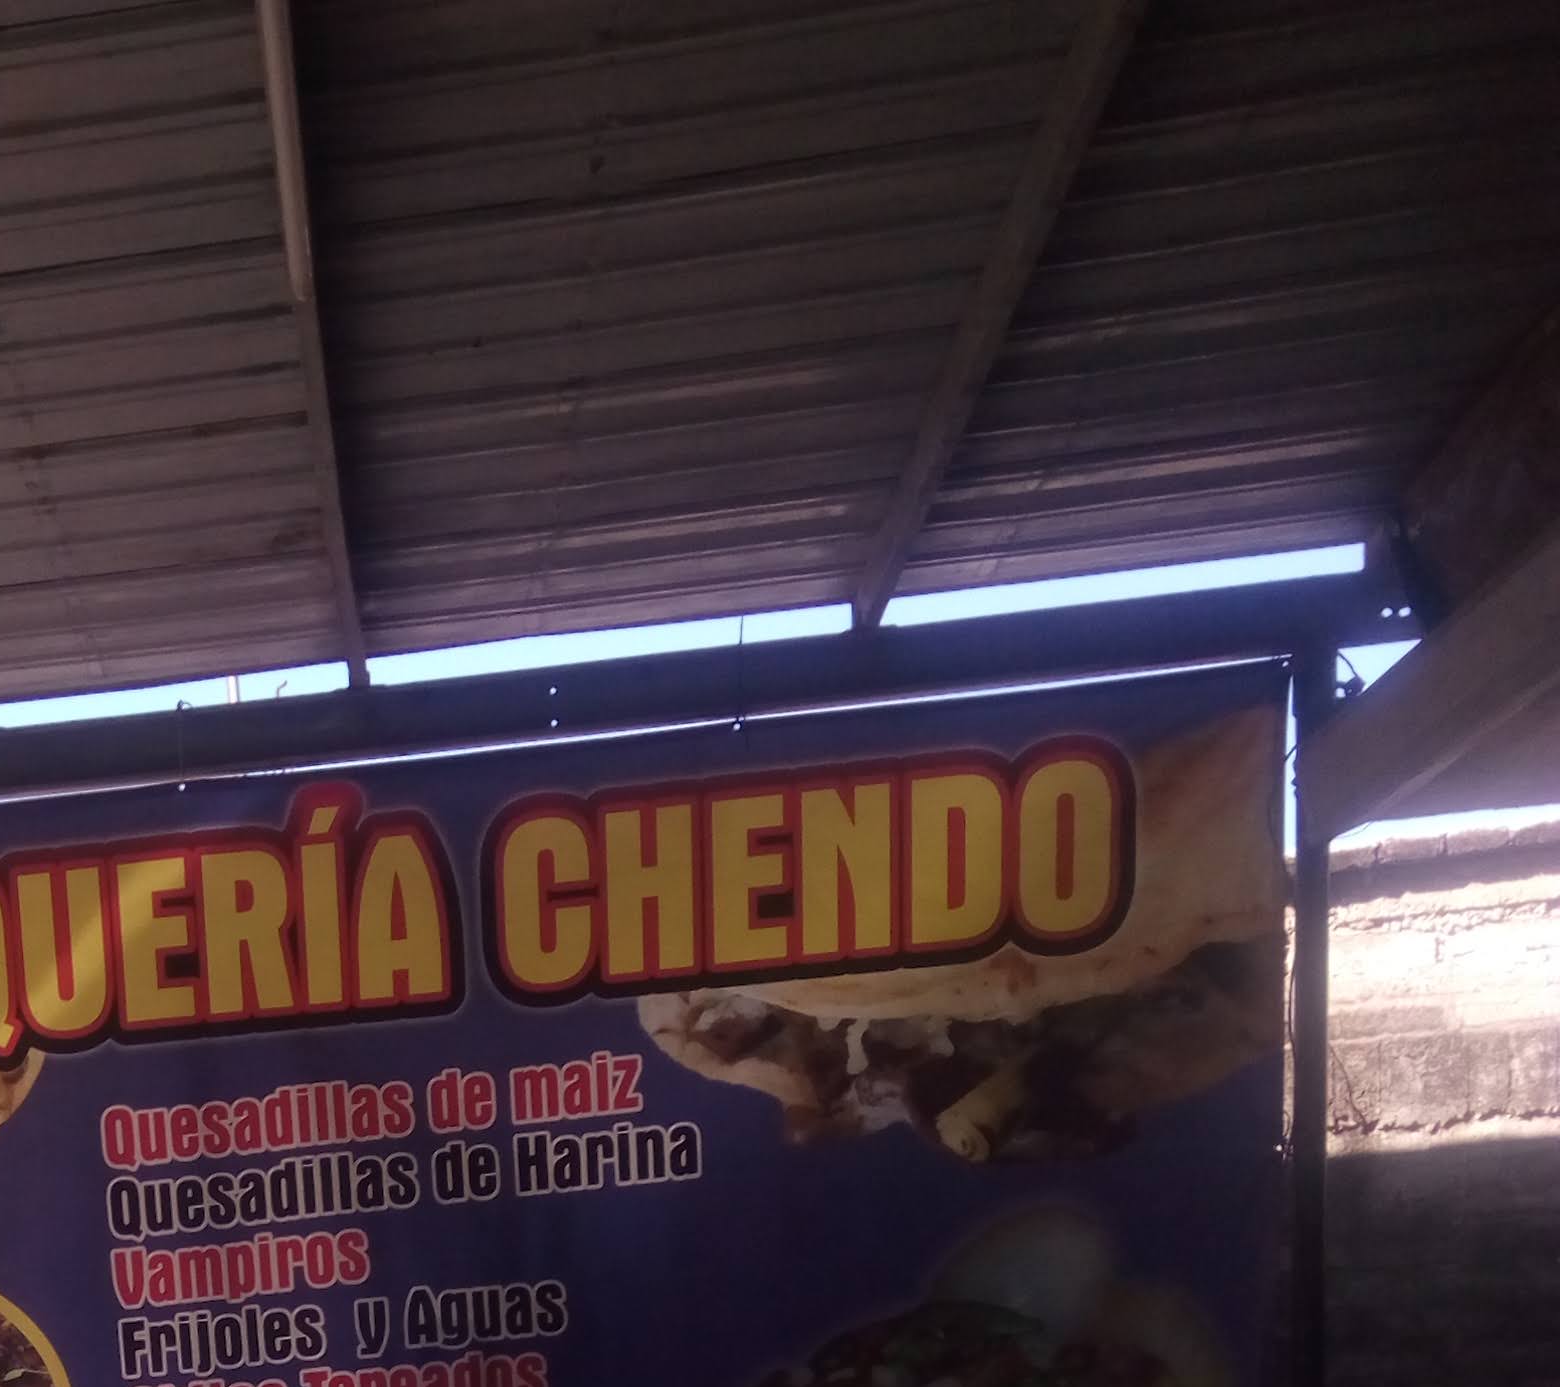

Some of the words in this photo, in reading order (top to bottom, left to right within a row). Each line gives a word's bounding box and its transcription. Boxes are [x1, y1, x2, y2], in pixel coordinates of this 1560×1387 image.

[496, 750, 1122, 994] CHENDO
[101, 1080, 415, 1169] Quesadillas
[427, 1069, 496, 1134] de
[510, 1051, 643, 1124] maiz
[107, 1151, 418, 1242] Quesadillas
[432, 1142, 499, 1204] de
[515, 1122, 702, 1197] Harina
[111, 1228, 370, 1309] Vampiros
[118, 1303, 326, 1379] Frijoles
[404, 1280, 568, 1352] Aguas
